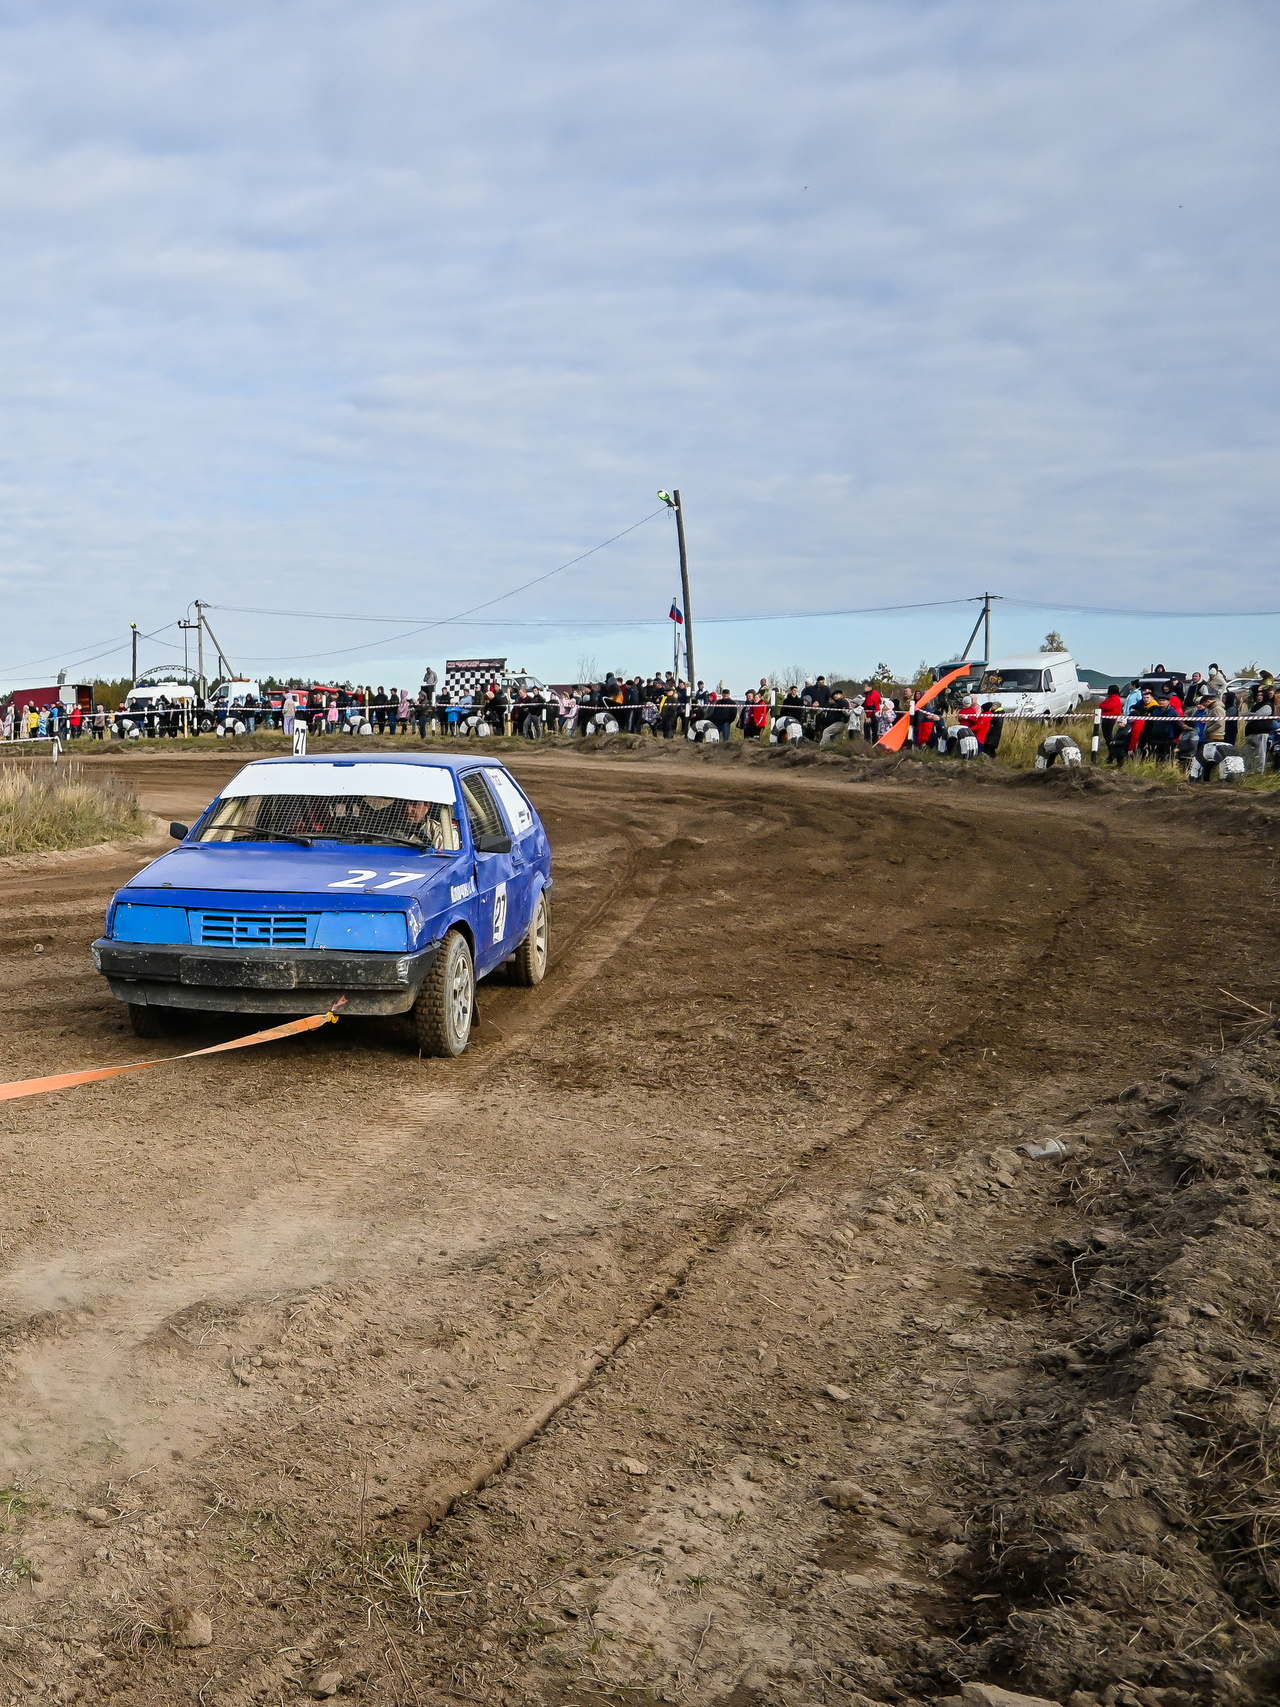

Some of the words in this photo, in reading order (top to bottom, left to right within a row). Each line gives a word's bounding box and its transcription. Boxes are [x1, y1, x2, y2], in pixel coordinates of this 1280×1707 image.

[294, 727, 306, 755] 27
[327, 869, 426, 889] 27
[494, 894, 507, 934] 27
